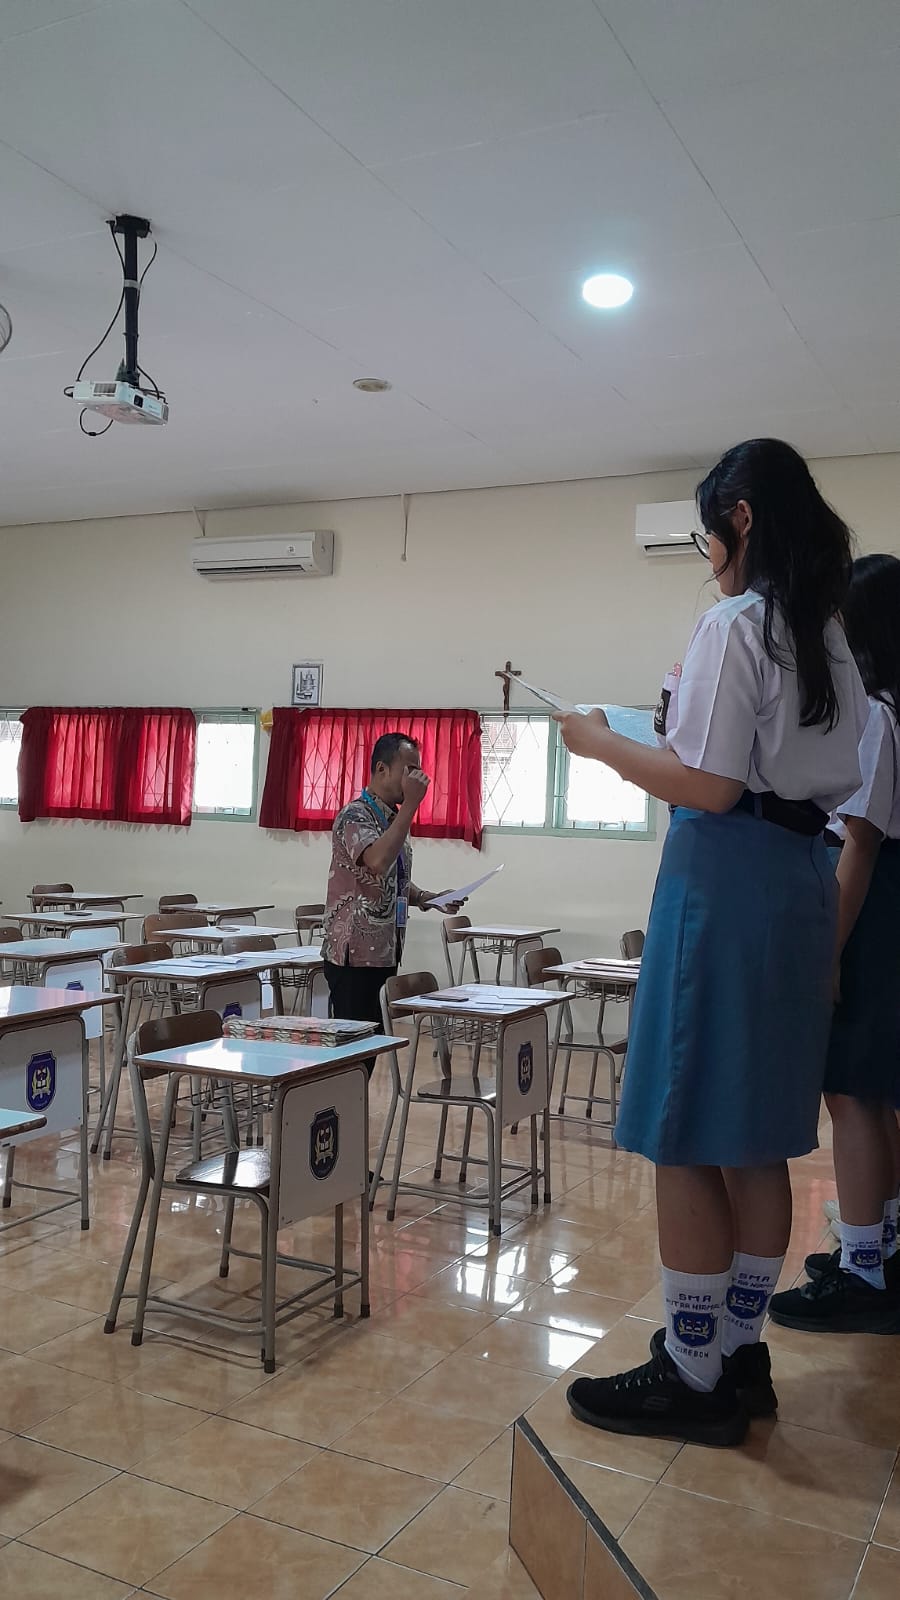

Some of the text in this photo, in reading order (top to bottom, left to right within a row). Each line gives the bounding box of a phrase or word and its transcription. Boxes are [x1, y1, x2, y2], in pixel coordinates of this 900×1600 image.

[738, 1272, 770, 1282] SMA
[678, 1293, 712, 1303] SMA
[675, 1345, 709, 1358] CIREBON
